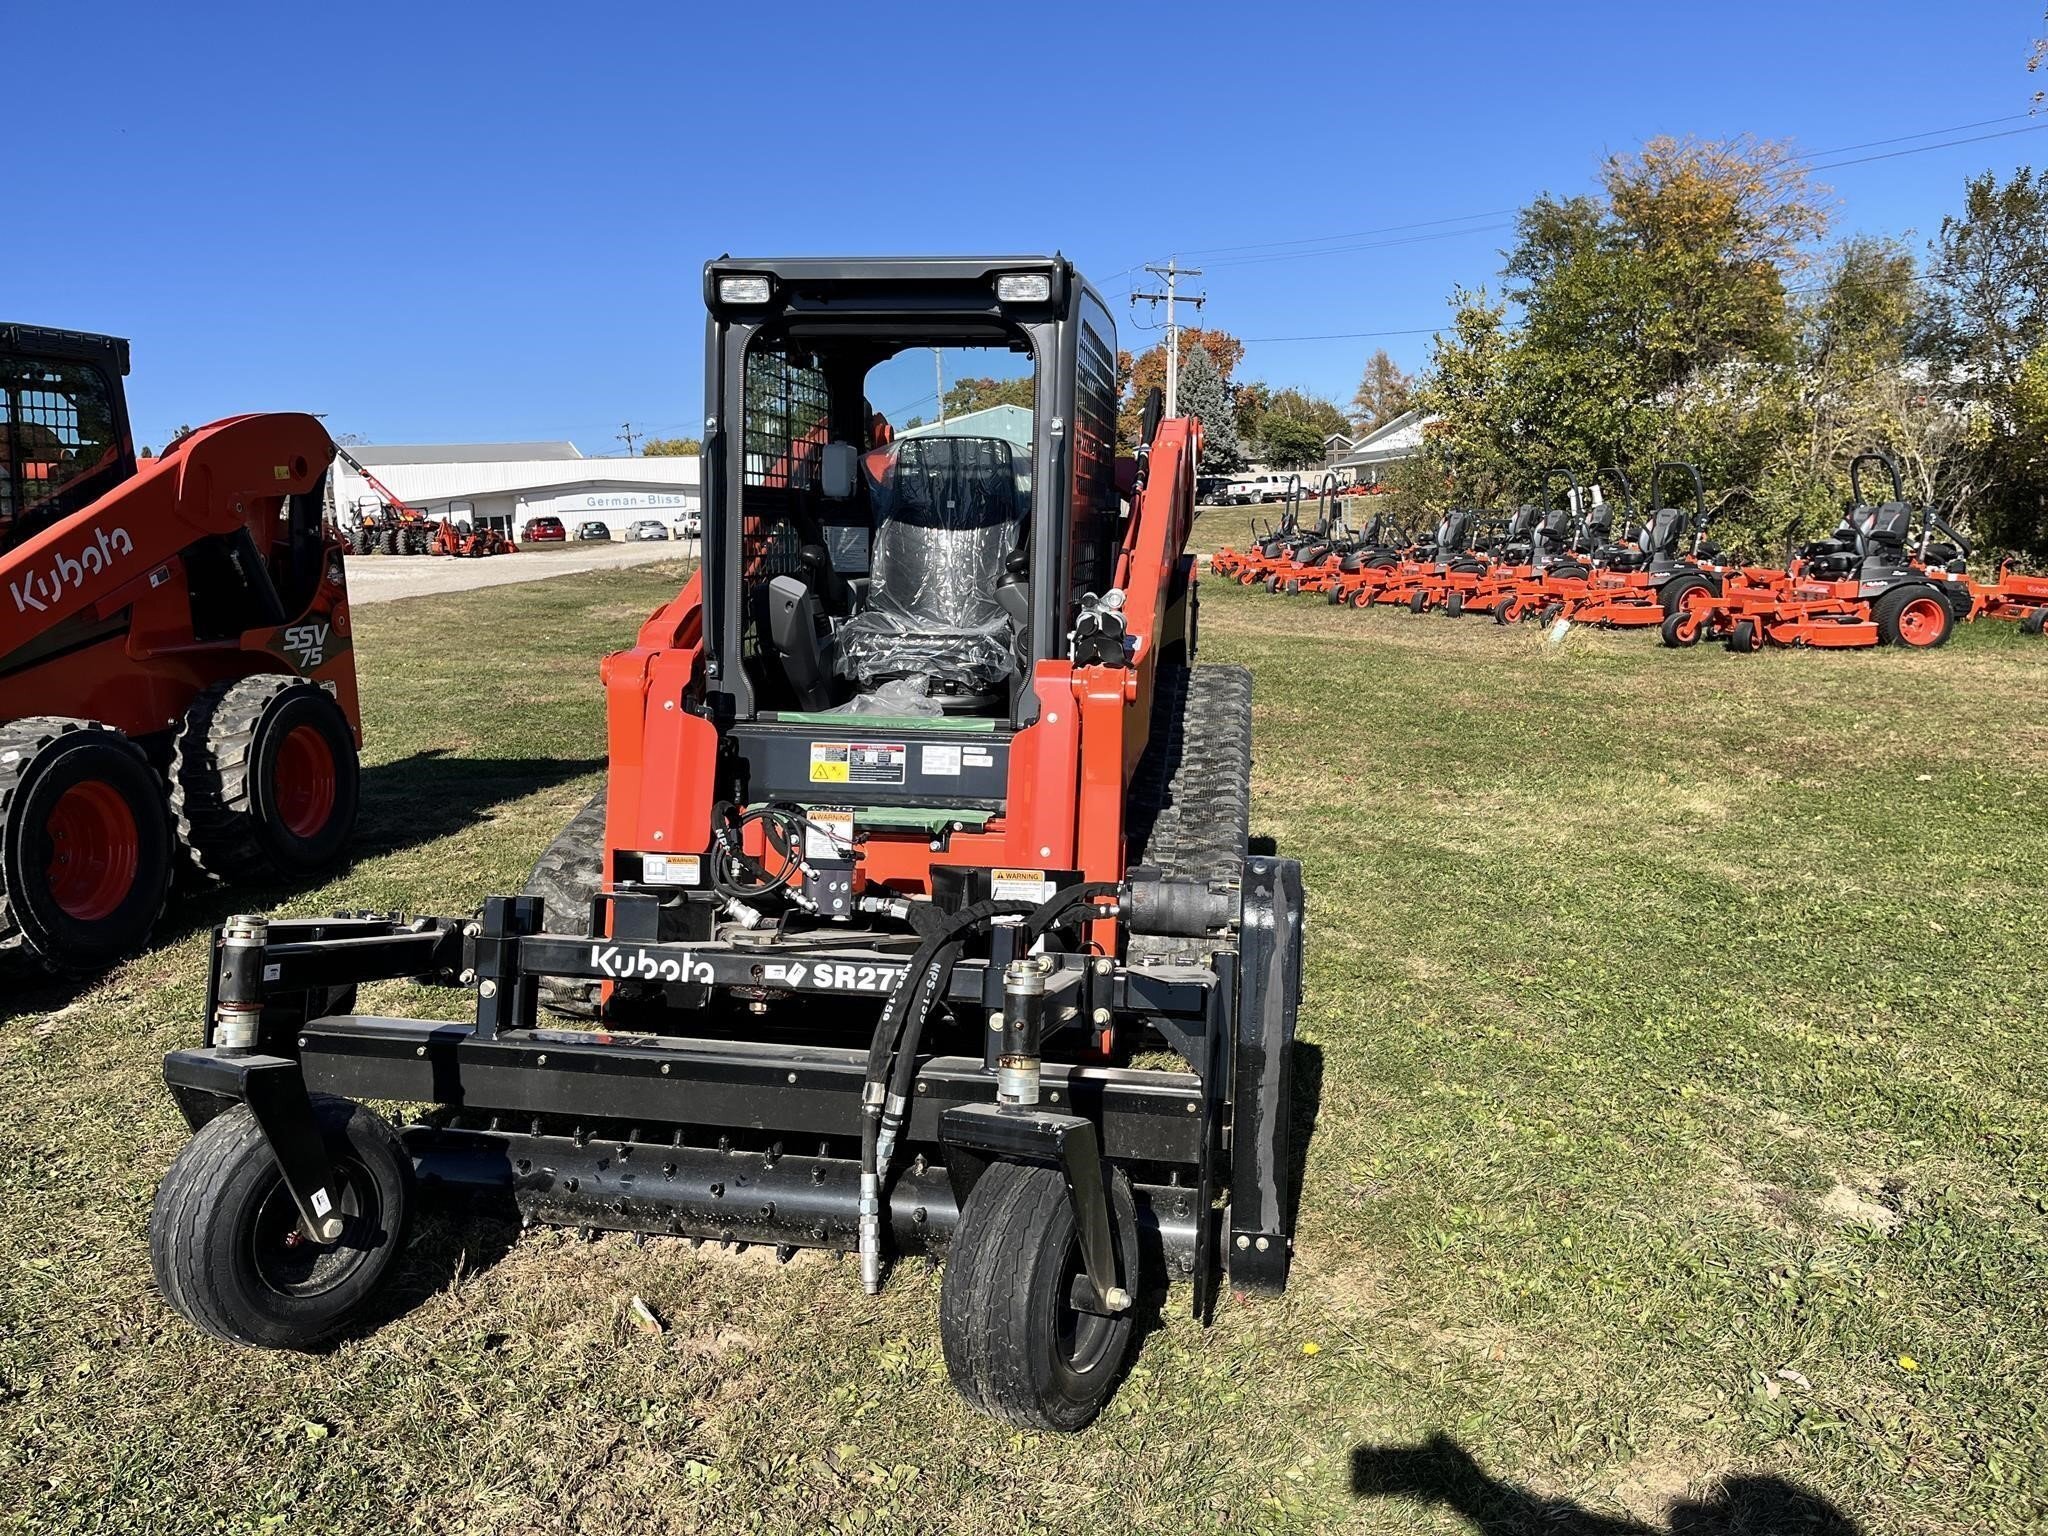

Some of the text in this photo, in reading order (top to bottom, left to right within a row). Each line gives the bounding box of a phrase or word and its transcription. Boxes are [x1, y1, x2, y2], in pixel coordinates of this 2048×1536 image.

[10, 527, 134, 613] Kubota
[283, 623, 330, 651] SSV
[300, 646, 323, 668] 75
[817, 813, 851, 822] WARNING
[1005, 872, 1039, 880] WARNING
[591, 945, 715, 985] Kubota
